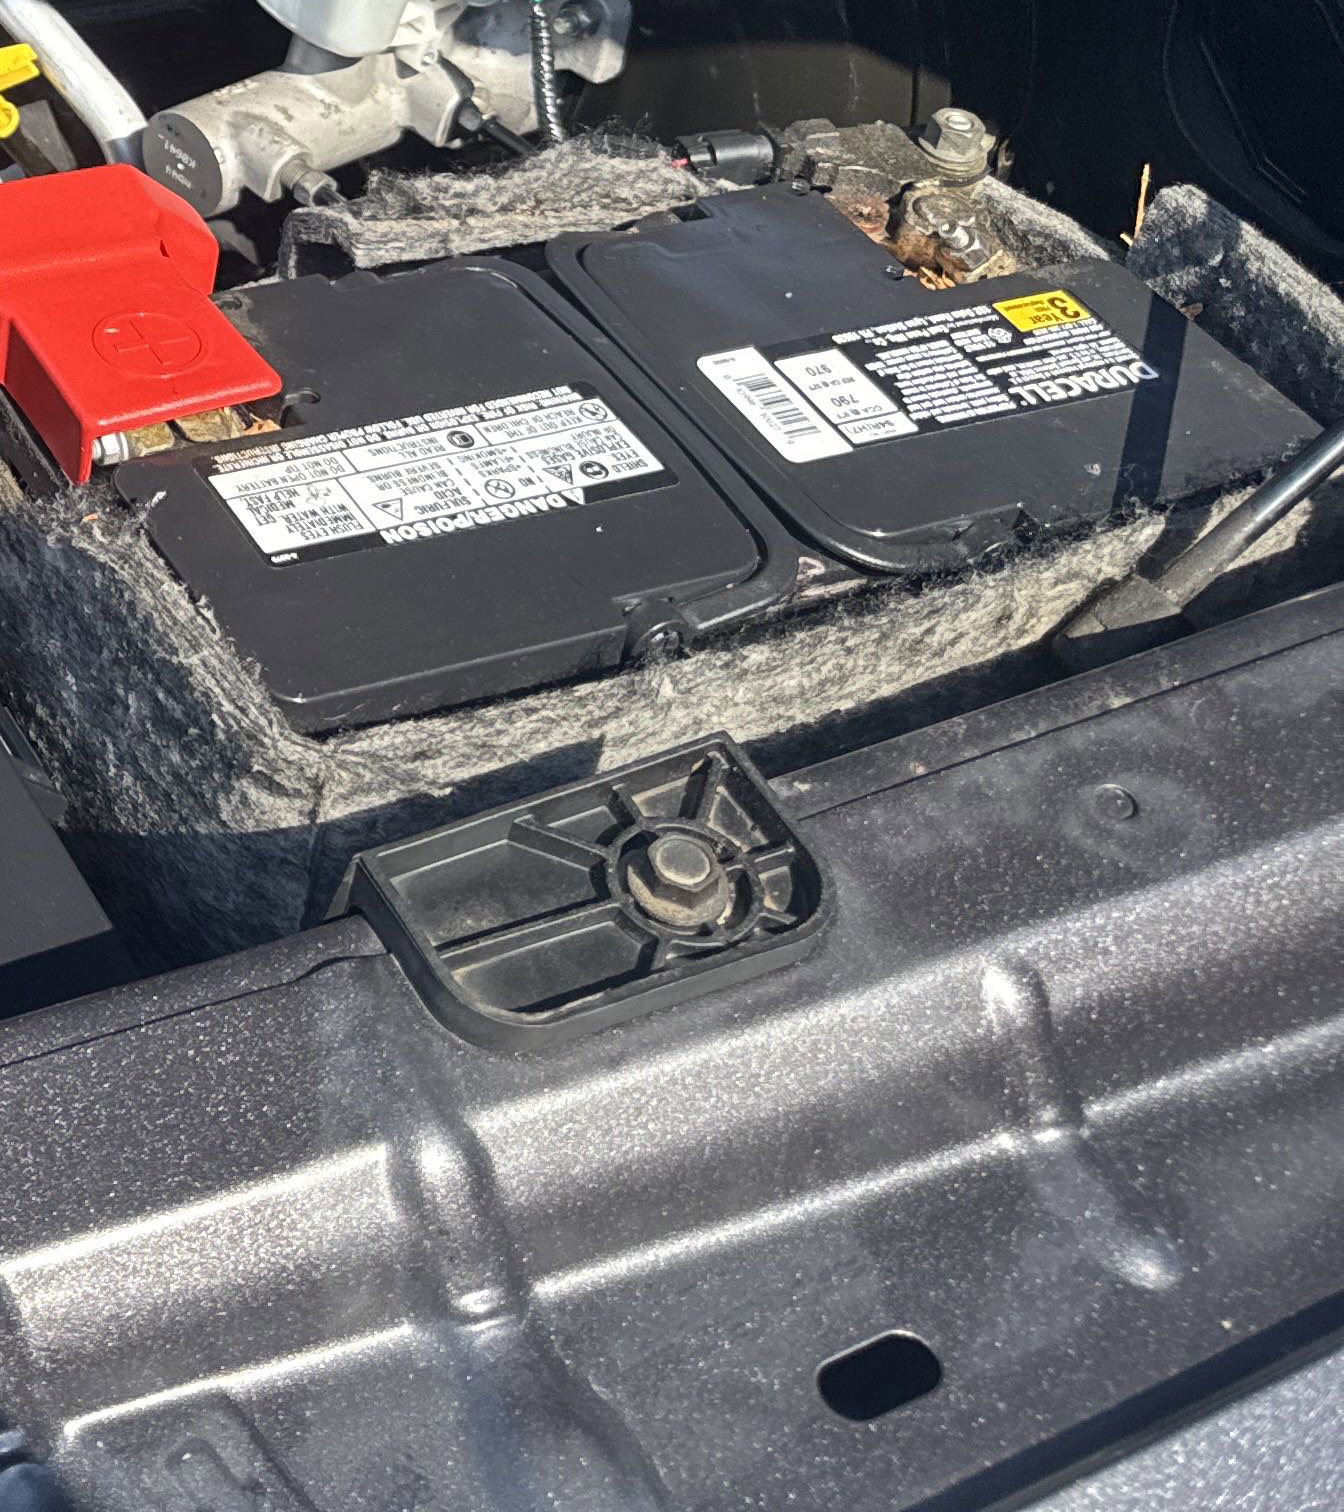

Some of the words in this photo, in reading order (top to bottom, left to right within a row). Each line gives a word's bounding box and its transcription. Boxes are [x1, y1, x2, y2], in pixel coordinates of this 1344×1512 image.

[1043, 294, 1084, 320] 3
[1027, 311, 1063, 326] Year
[802, 363, 833, 376] 970
[1005, 358, 1161, 408] DURACELL
[827, 393, 860, 407] 790
[481, 417, 530, 433] CHILDREN
[536, 420, 559, 431] OUT
[556, 415, 584, 427] KEEP
[503, 427, 524, 438] THE
[522, 424, 538, 434] OF
[365, 435, 439, 457] INSTRUCTIONS
[416, 443, 446, 455] READ
[574, 439, 631, 458] EXPLOSIVE
[321, 456, 339, 465] DO
[396, 449, 419, 460] ALL
[539, 451, 576, 465] GASES
[300, 459, 322, 470] NOT
[327, 463, 346, 474] DO
[402, 461, 441, 475] SEVERE
[610, 458, 649, 473] SHIELD
[277, 471, 307, 484] OPEN
[306, 467, 329, 478] NOT
[391, 469, 448, 487] BLINDNESS
[374, 481, 392, 491] OR
[431, 478, 455, 489] CAN
[517, 476, 535, 487] NO
[269, 487, 300, 501] HELP
[398, 482, 433, 496] CAUSE
[431, 486, 463, 500] ACID
[244, 498, 296, 516] MEDICAL
[318, 501, 349, 516] WITH
[412, 495, 472, 515] SULFURIC
[252, 512, 277, 526] GET
[282, 510, 356, 534] IMMEDIATELY
[377, 492, 567, 544] DANGER/POISON
[327, 519, 364, 535] FLUSH
